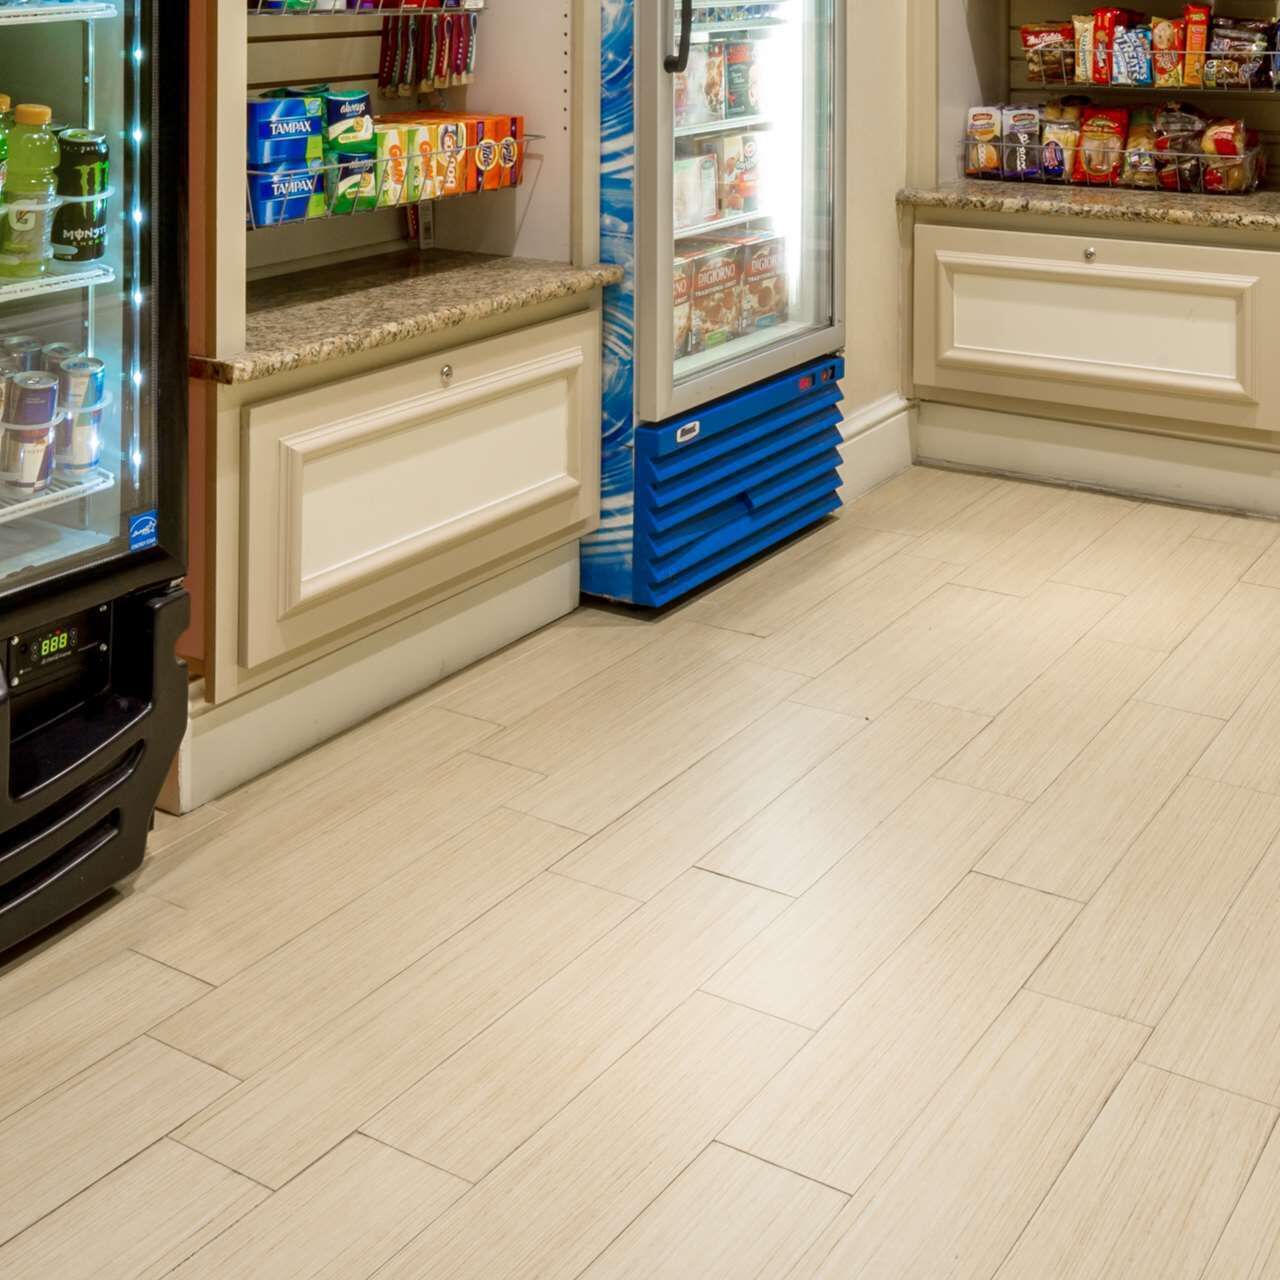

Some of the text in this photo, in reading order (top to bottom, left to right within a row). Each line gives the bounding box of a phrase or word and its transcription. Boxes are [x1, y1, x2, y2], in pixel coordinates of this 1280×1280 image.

[1115, 33, 1140, 80] TREATS
[340, 101, 366, 115] always
[270, 120, 312, 135] TAMPAX
[272, 179, 314, 195] TAMPAX
[63, 224, 106, 241] MONST
[698, 263, 736, 287] DIGIORNO
